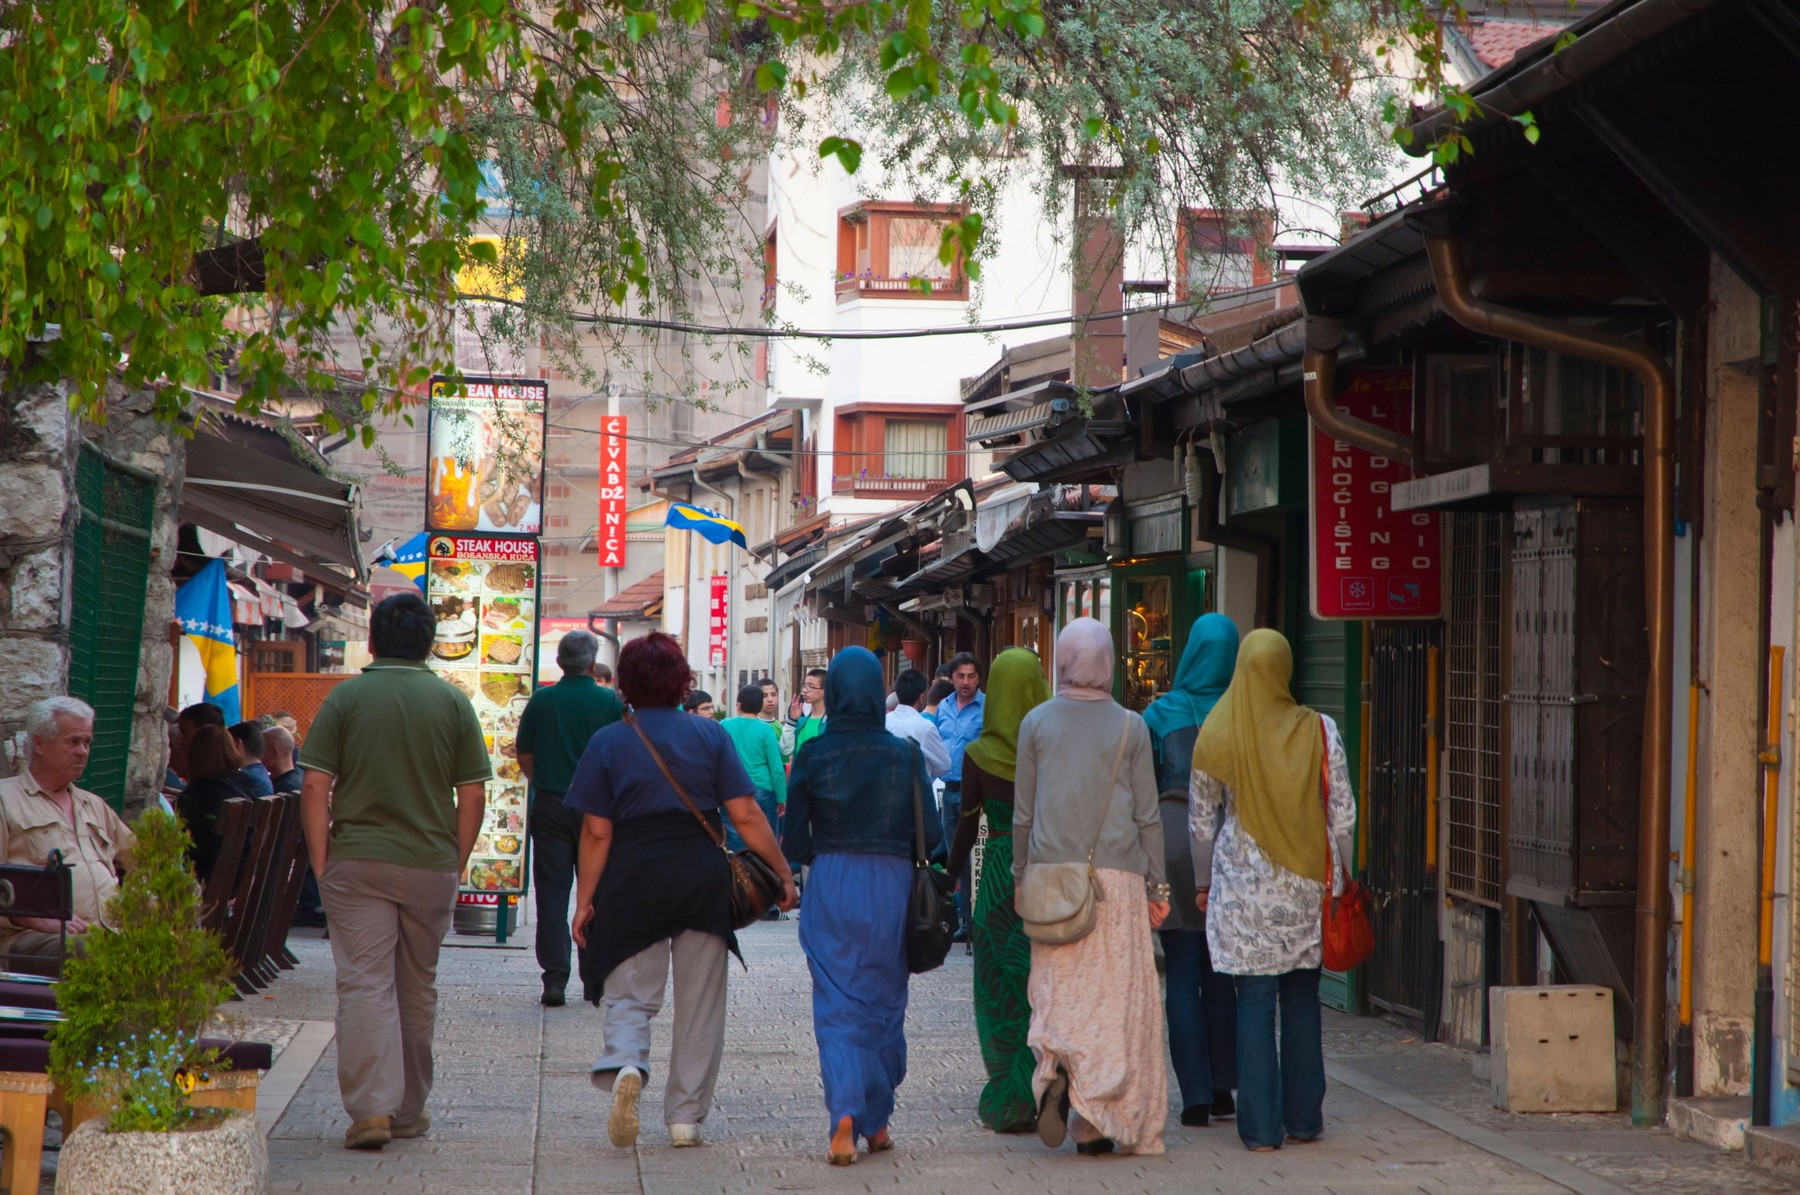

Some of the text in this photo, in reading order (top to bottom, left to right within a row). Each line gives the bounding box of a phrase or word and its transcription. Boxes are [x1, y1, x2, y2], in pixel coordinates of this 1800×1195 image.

[450, 384, 544, 400] EAK HOUSE
[456, 539, 535, 554] STEAK HOUSE
[600, 418, 625, 563] ĆEVABDŽINICA
[1332, 405, 1353, 570] ENOĆIŠTE
[1370, 405, 1390, 570] LDGING
